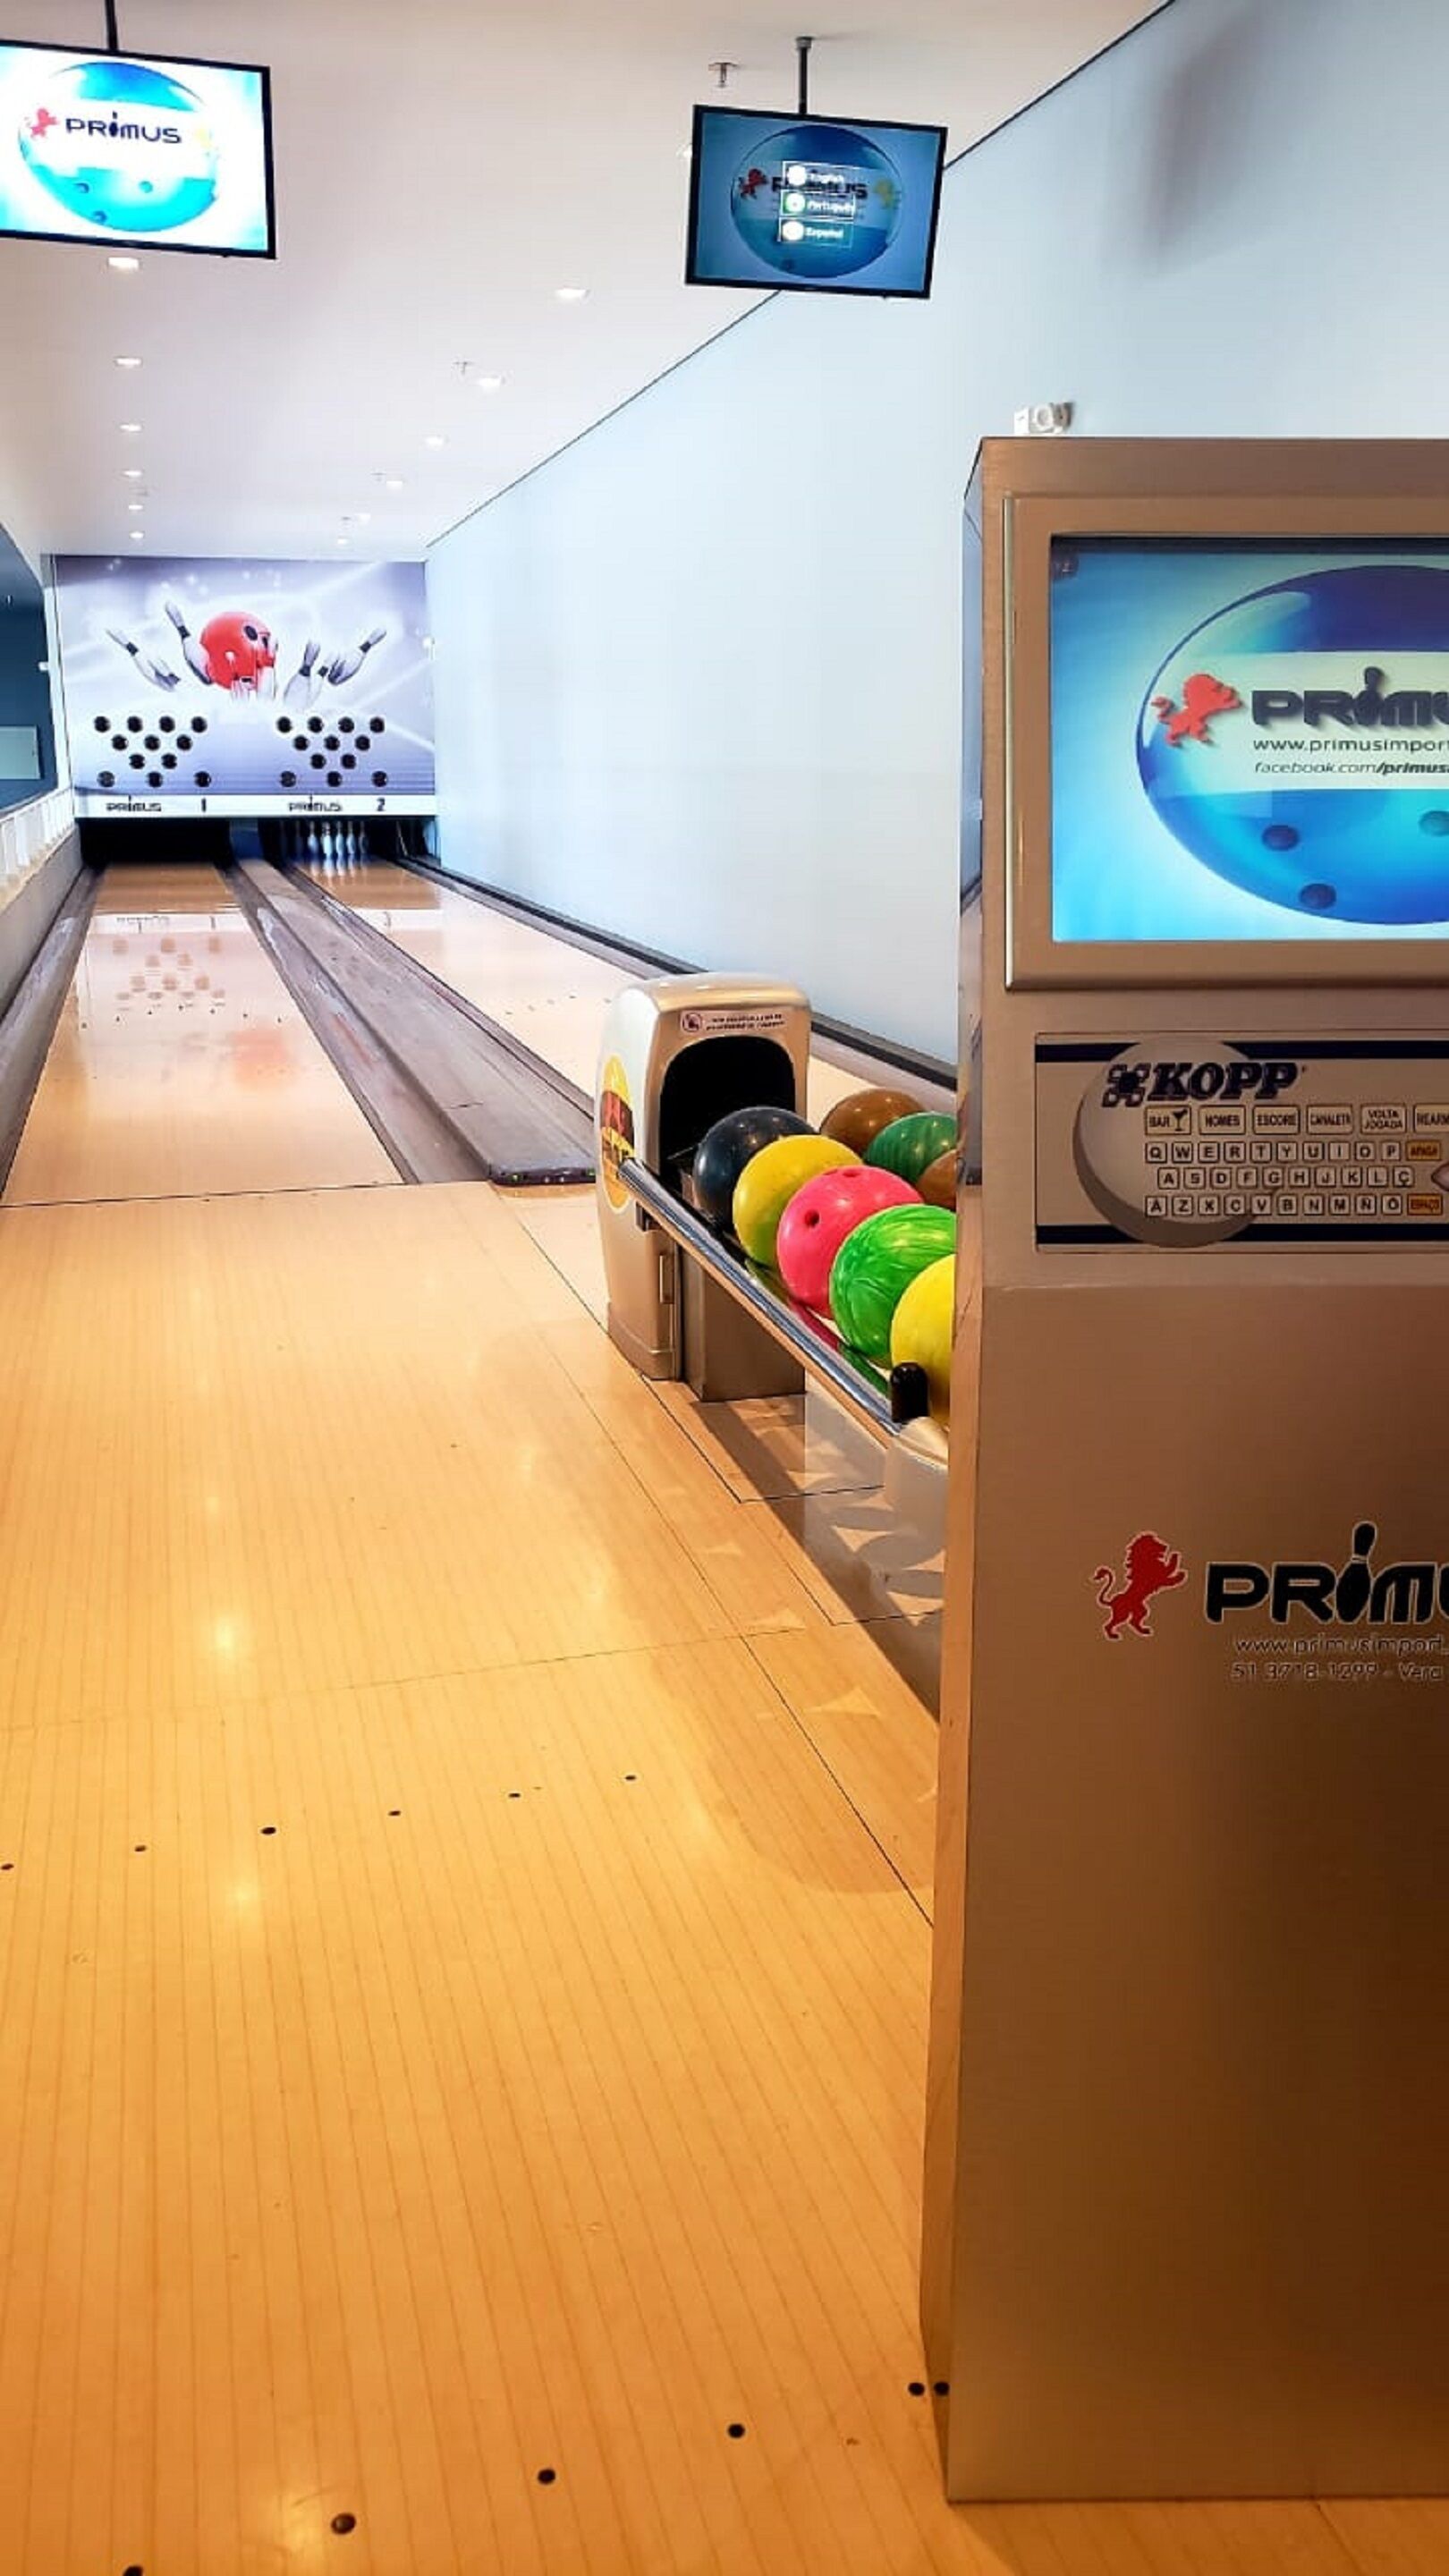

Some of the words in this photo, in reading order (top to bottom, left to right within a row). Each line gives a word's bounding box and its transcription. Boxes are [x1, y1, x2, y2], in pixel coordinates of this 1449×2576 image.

[65, 111, 182, 143] PRIMUS
[200, 798, 207, 812] 1
[376, 798, 386, 812] 2
[1147, 1063, 1298, 1101] KOPP
[1149, 1117, 1170, 1128] BAR
[1205, 1116, 1241, 1127] NOMES
[1149, 1147, 1162, 1159] Q
[1175, 1147, 1190, 1158] W
[1204, 1147, 1215, 1158] E
[1230, 1147, 1241, 1158] R
[1256, 1146, 1266, 1157] T
[1281, 1147, 1292, 1157] Y
[1308, 1147, 1319, 1158] U
[1337, 1146, 1342, 1157] I
[1360, 1147, 1370, 1157] O
[1387, 1146, 1395, 1157] P
[1164, 1173, 1174, 1184] A
[1191, 1173, 1200, 1184] S
[1216, 1173, 1226, 1183] D
[1244, 1173, 1253, 1183] F
[1268, 1172, 1279, 1183] G
[1294, 1172, 1305, 1183] H
[1322, 1172, 1329, 1183] J
[1348, 1172, 1358, 1182] K
[1374, 1171, 1383, 1182] L
[1179, 1199, 1189, 1212] Z
[1205, 1199, 1214, 1211] X
[1231, 1199, 1241, 1211] C
[1257, 1199, 1267, 1211] V
[1284, 1199, 1292, 1211] B
[1309, 1199, 1319, 1210] N
[1334, 1199, 1345, 1210] M
[1206, 1521, 1449, 1624] PRIM
[1231, 1661, 1256, 1680] 51
